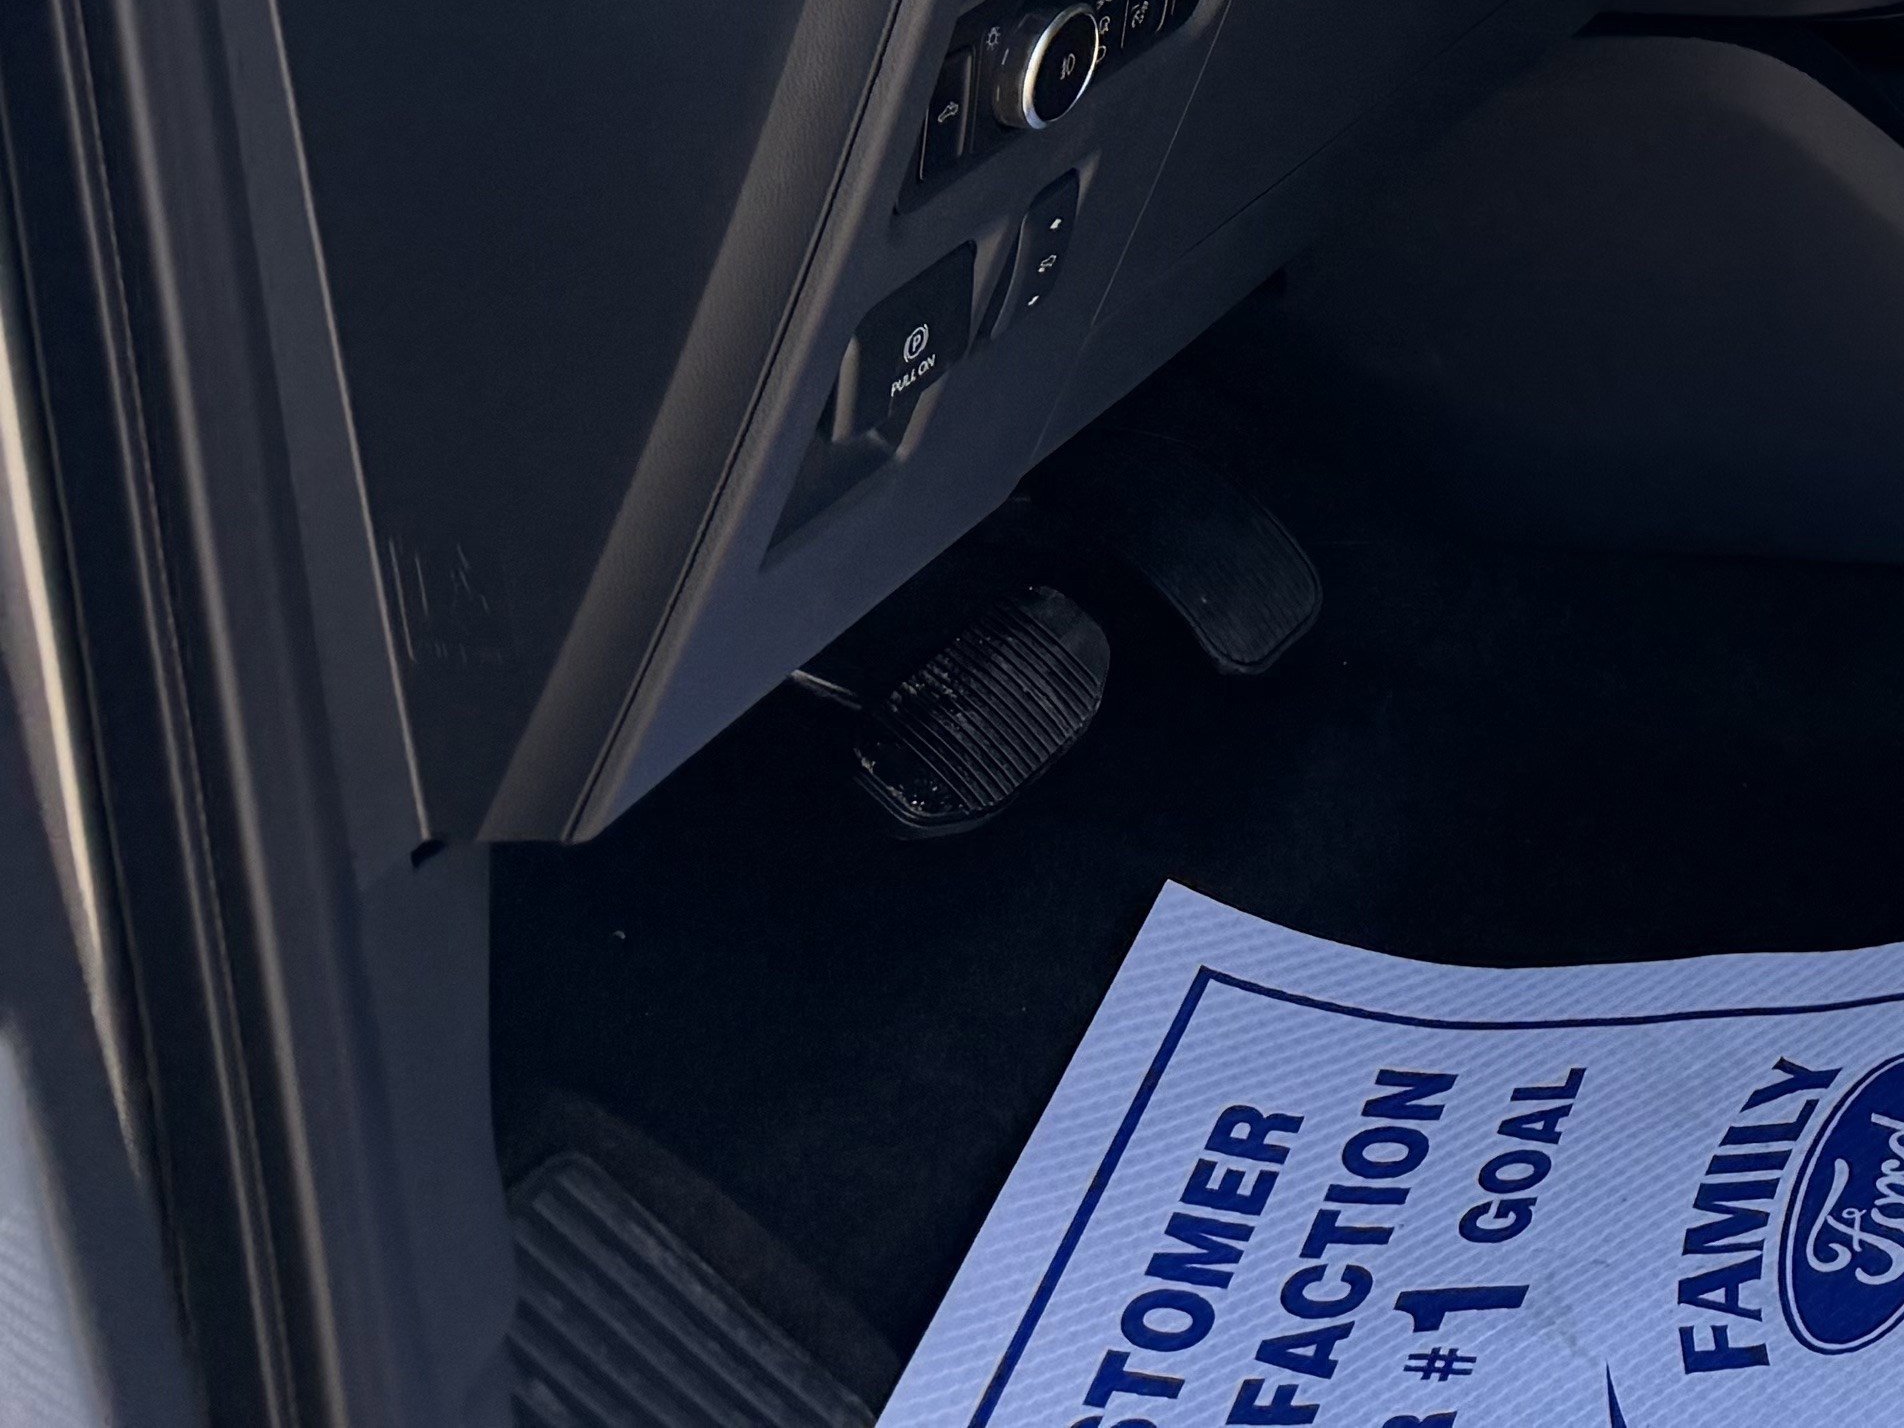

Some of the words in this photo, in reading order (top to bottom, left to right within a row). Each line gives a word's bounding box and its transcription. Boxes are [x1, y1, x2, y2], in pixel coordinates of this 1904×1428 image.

[890, 369, 917, 397] PULL
[918, 354, 935, 375] ON
[1459, 1067, 1588, 1244] GOAL
[1678, 1055, 1842, 1376] FAMILY
[1070, 1104, 1305, 1428] TOMER
[1394, 1284, 1530, 1383] #1
